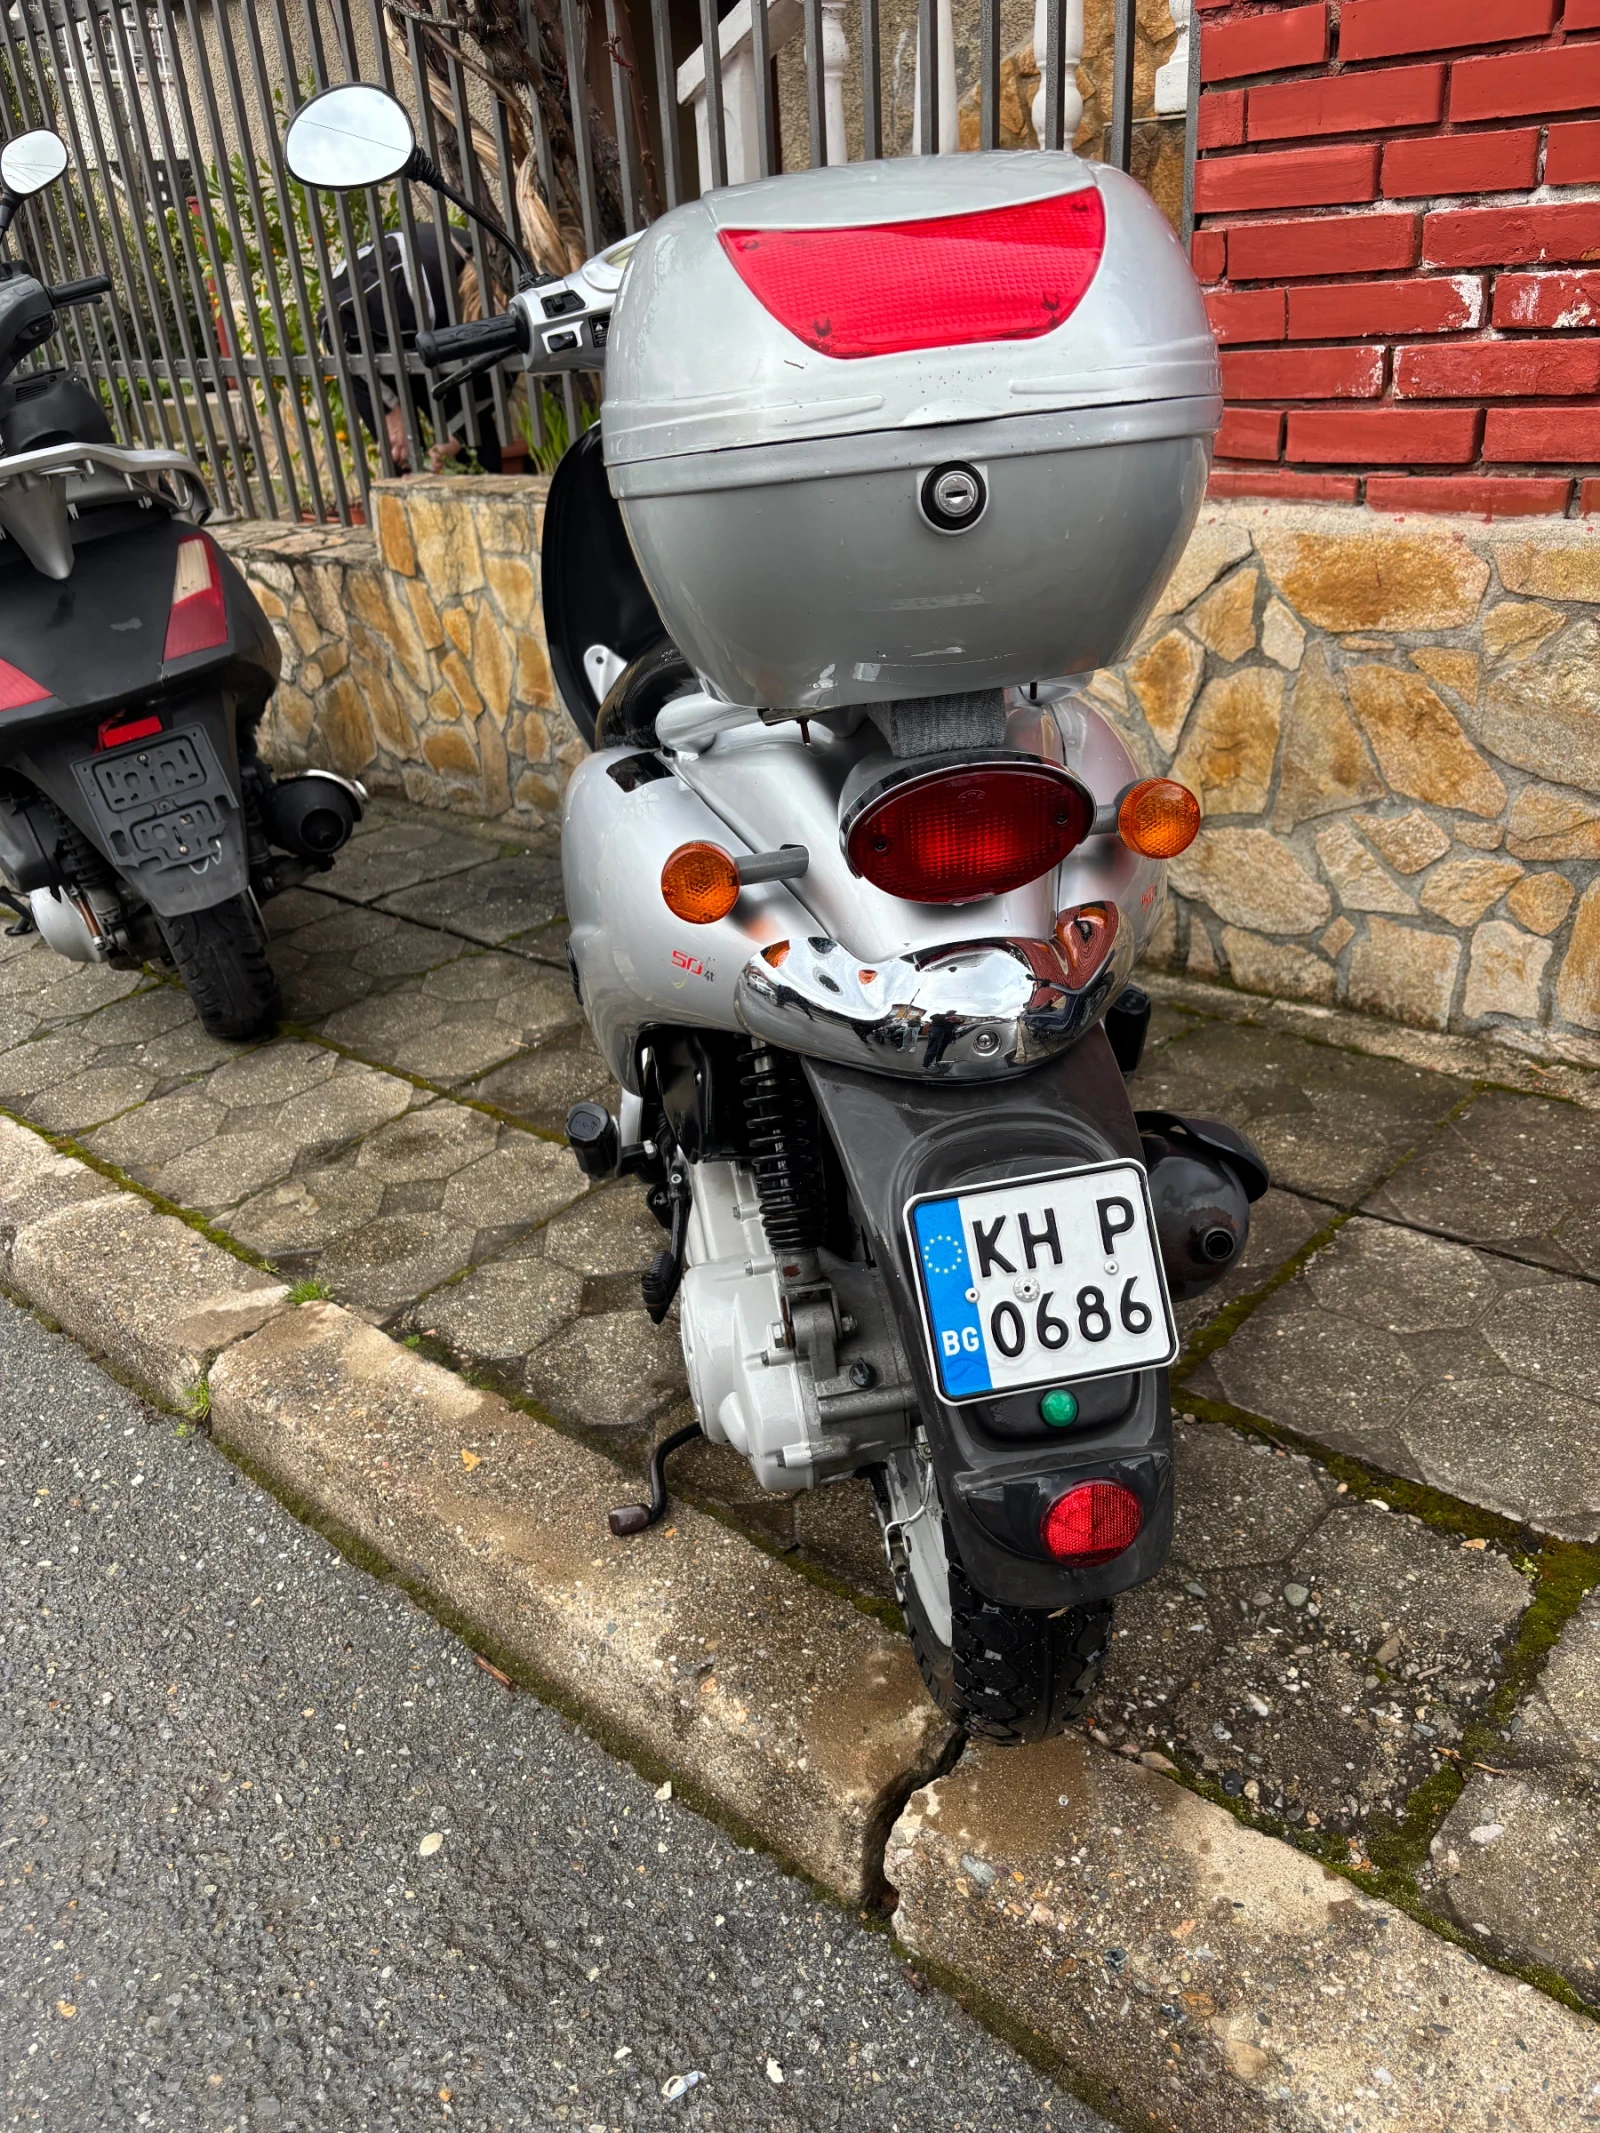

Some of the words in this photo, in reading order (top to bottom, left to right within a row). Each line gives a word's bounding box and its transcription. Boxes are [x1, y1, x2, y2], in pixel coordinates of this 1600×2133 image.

[671, 950, 703, 976] 50
[972, 1207, 1063, 1278] KH
[1096, 1196, 1135, 1255] P
[941, 1327, 980, 1356] BG
[990, 1276, 1153, 1358] 0686
